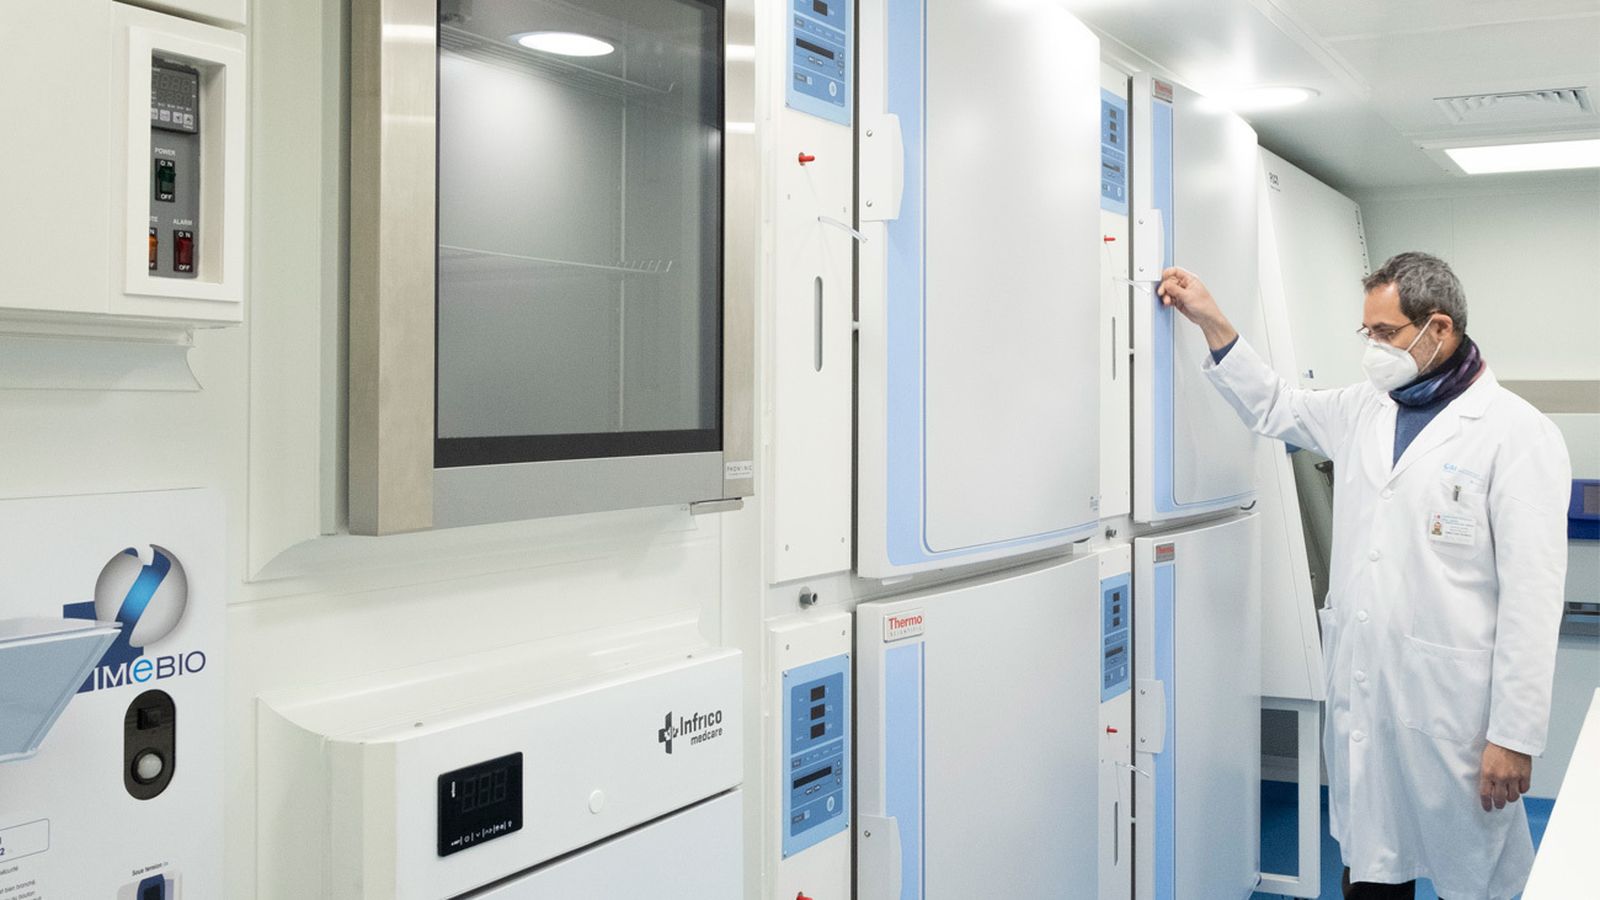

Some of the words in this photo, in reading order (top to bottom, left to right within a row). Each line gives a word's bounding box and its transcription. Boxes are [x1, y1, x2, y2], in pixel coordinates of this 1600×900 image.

[154, 147, 176, 156] POWER
[173, 218, 193, 226] ALARM
[888, 615, 923, 630] Thermo
[680, 710, 722, 736] Infrico
[690, 727, 723, 746] medcare
